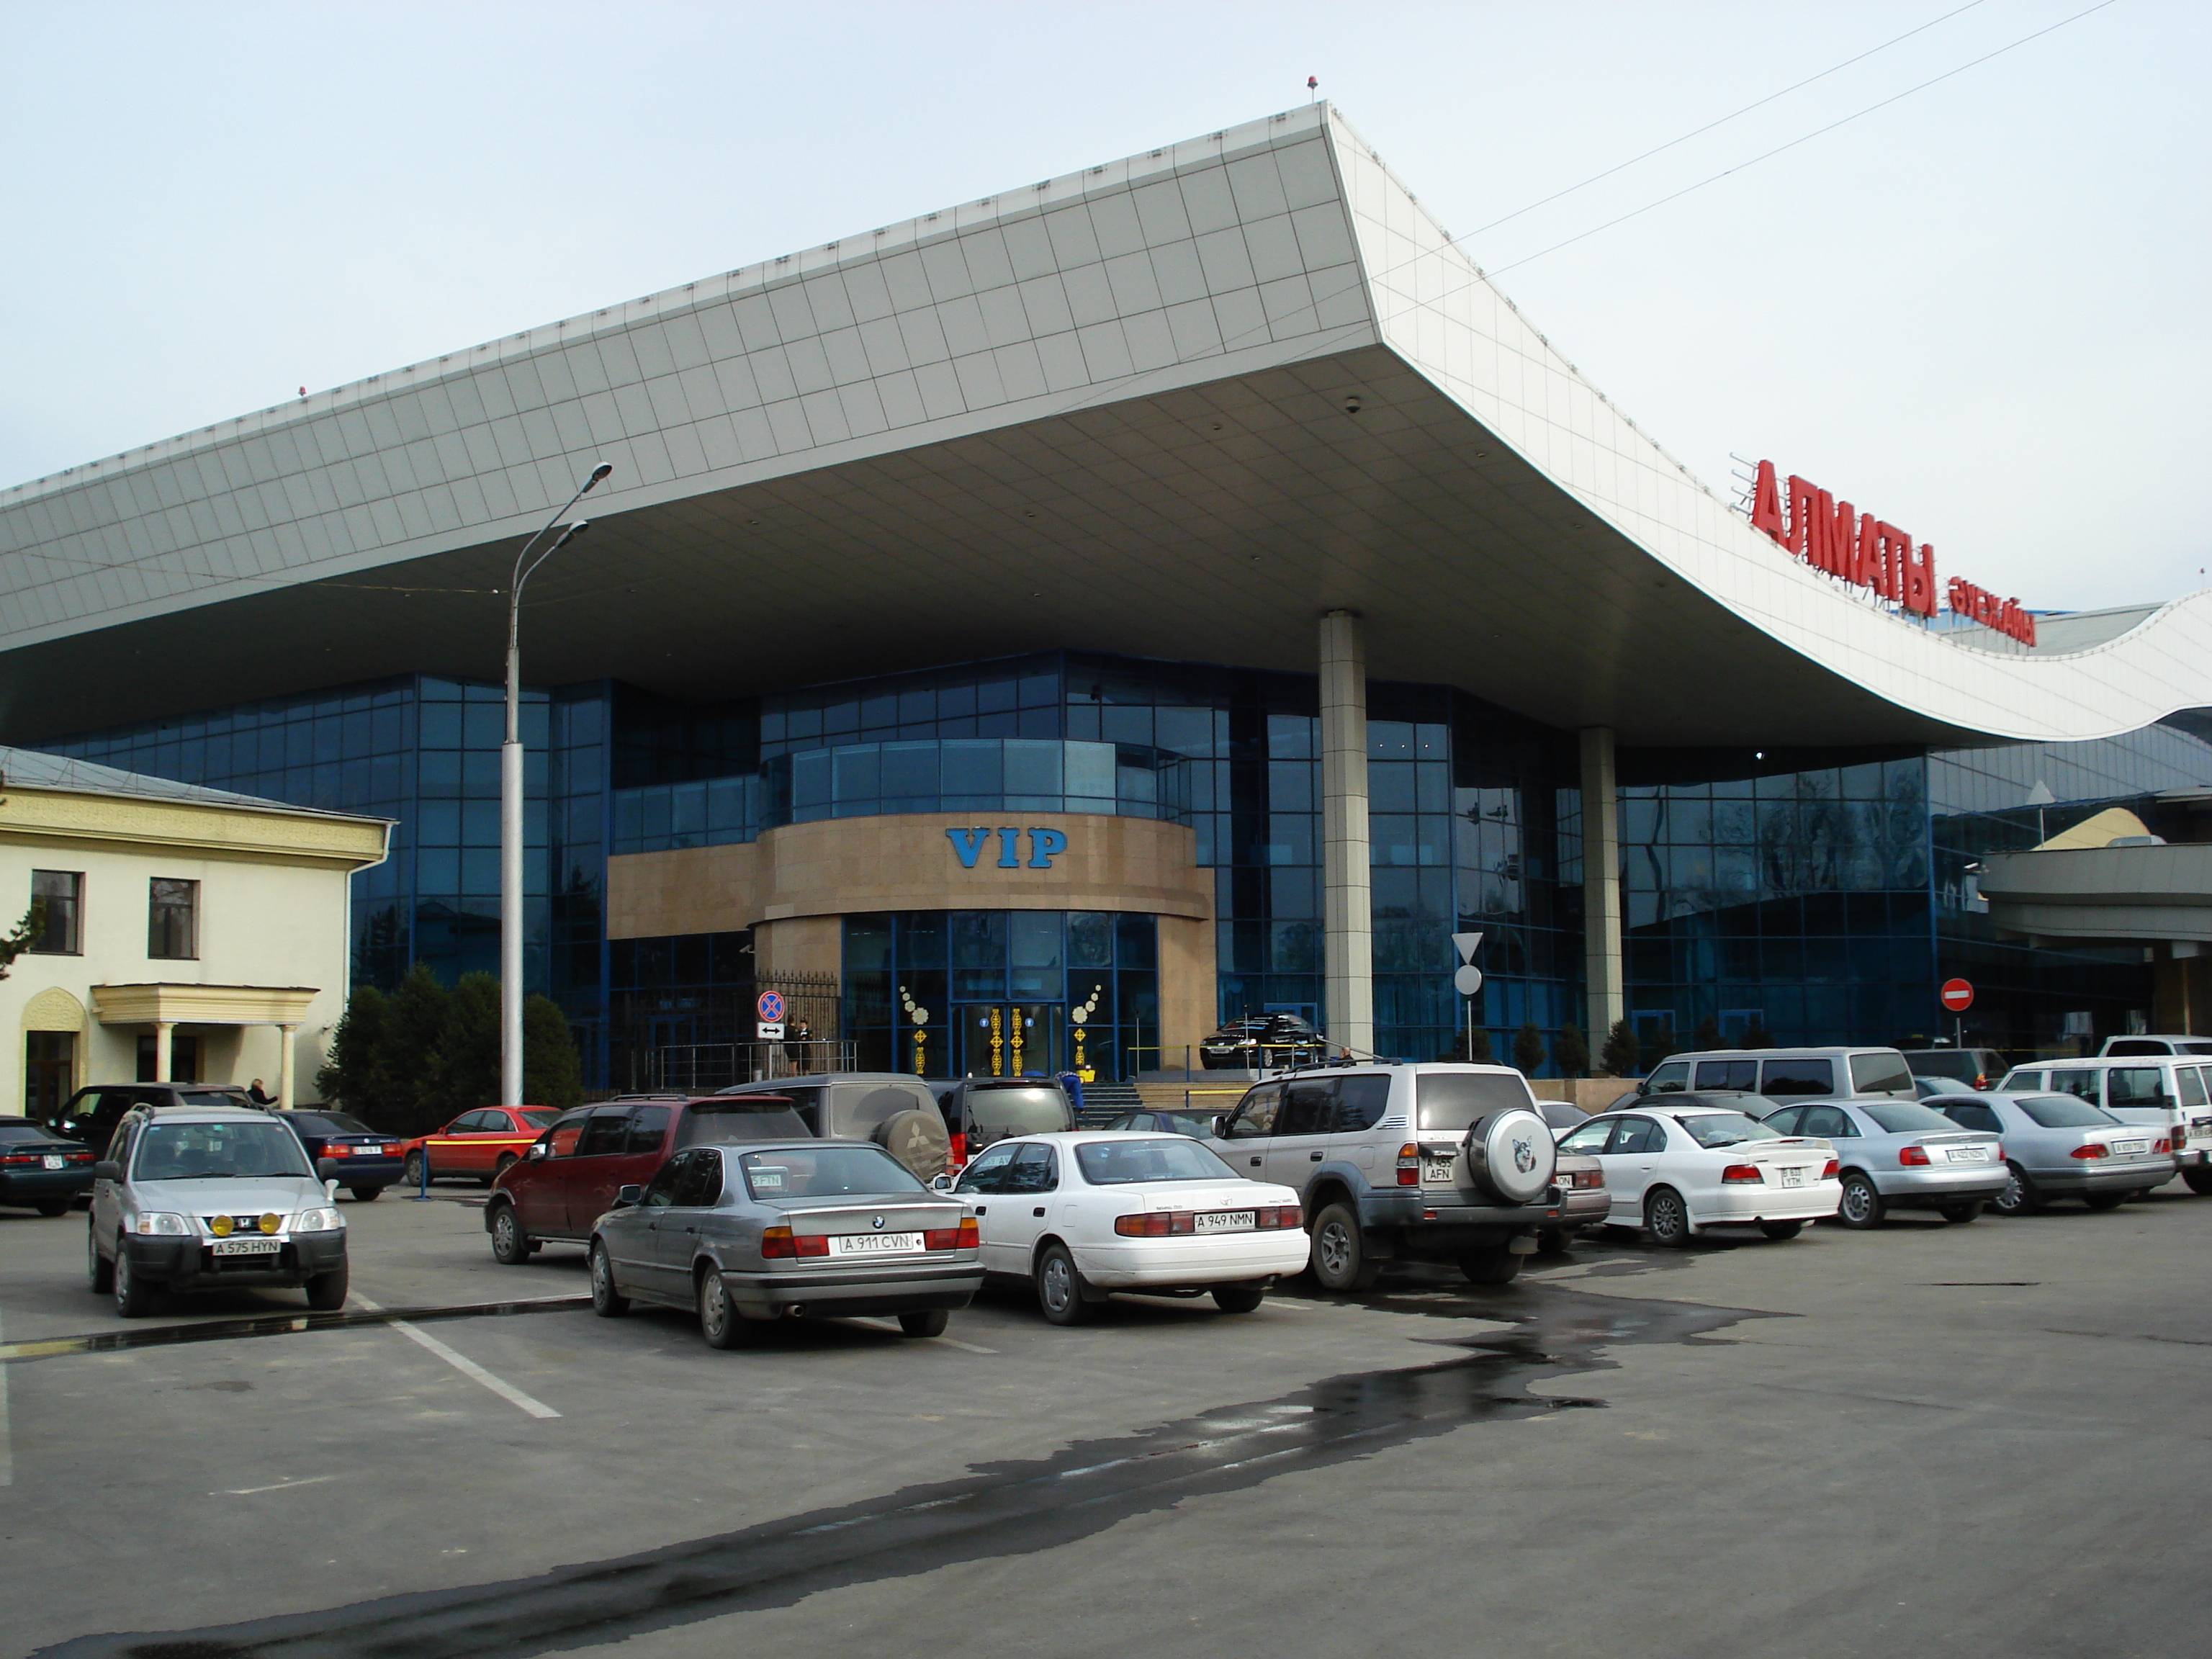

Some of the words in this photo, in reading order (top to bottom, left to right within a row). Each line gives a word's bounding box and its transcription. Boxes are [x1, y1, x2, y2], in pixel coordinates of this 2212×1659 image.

[1750, 459, 1938, 618] АЛМАТЫ
[945, 827, 1067, 868] VIP
[1426, 1158, 1432, 1167] A
[1437, 1158, 1452, 1167] 455
[760, 1175, 779, 1184] FTN
[1431, 1169, 1449, 1179] AFN
[1197, 1215, 1205, 1228] A
[1208, 1215, 1226, 1226] 949
[1230, 1213, 1253, 1225] NMN
[217, 1244, 225, 1254] A
[228, 1242, 248, 1254] 575
[252, 1241, 278, 1252] HYN
[845, 1238, 854, 1250] A
[858, 1236, 879, 1249] 911
[882, 1235, 909, 1248] CVN
